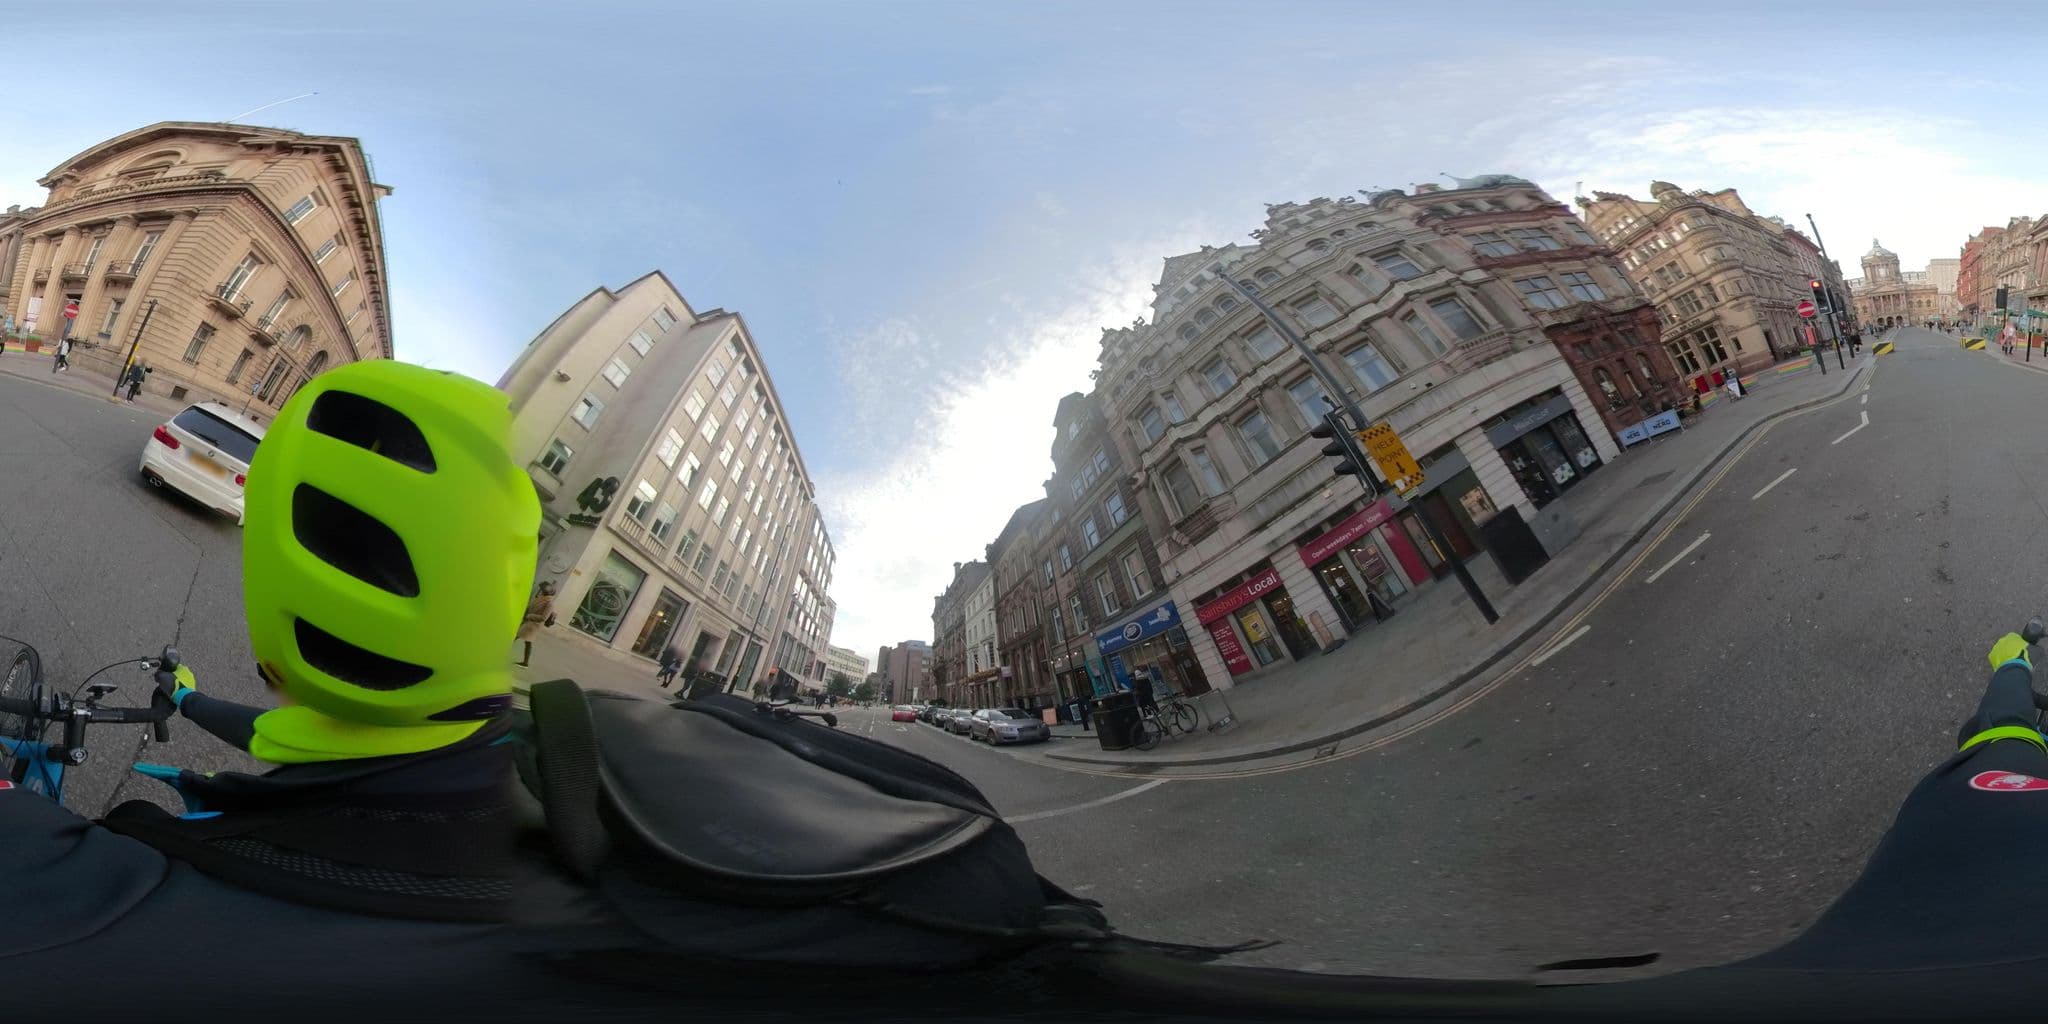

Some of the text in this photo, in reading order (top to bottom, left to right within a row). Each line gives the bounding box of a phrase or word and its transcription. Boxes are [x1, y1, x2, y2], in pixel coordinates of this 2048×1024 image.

[1653, 419, 1671, 430] NERO
[1374, 437, 1395, 450] HELP
[1378, 447, 1406, 463] POINT
[1311, 548, 1326, 559] Open
[1326, 531, 1352, 549] weekdays
[1350, 524, 1364, 534] 7am
[1199, 573, 1277, 620] Sainsbury's Local
